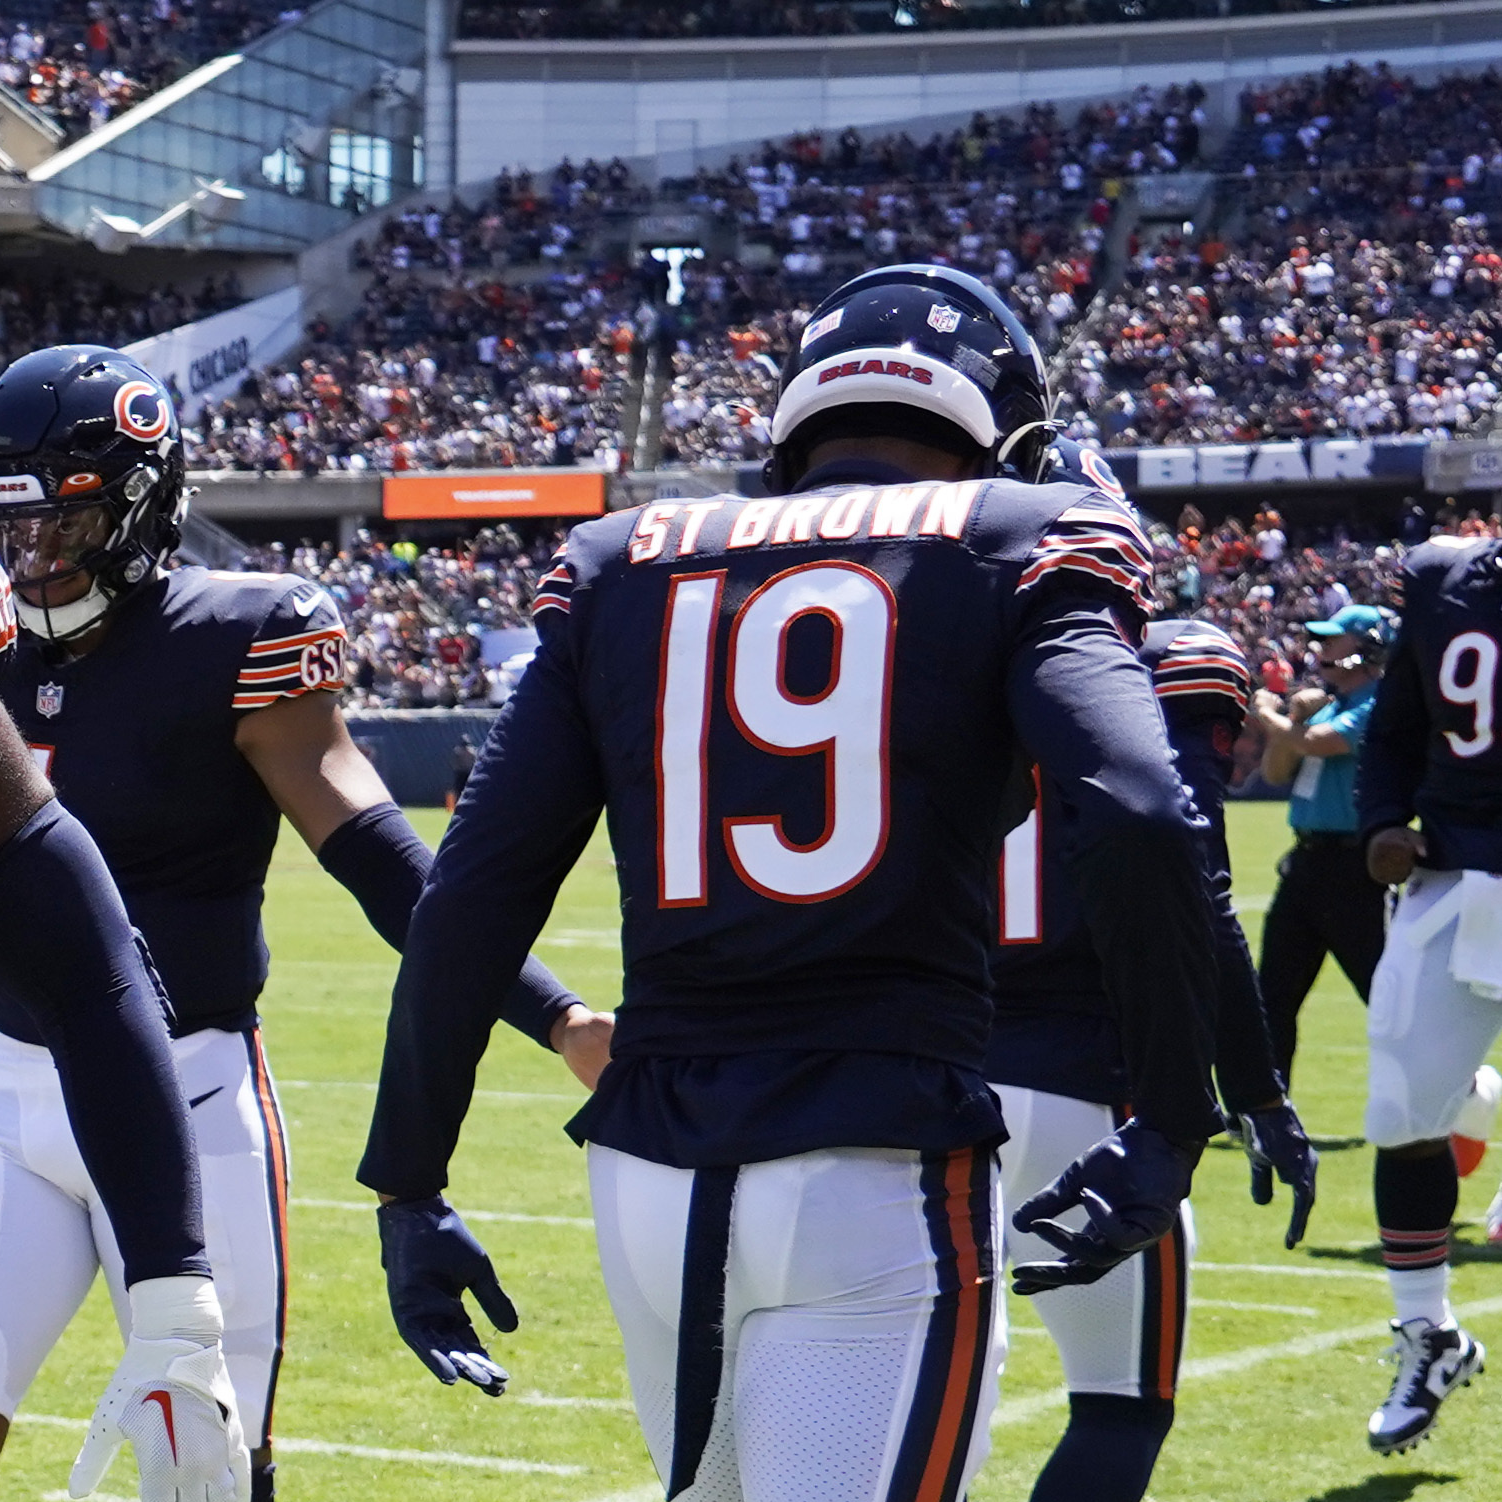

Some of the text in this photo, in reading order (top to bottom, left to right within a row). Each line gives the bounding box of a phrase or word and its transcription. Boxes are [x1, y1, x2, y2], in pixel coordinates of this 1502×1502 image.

[817, 360, 933, 385] BEARS
[1137, 440, 1374, 488] BEAR
[630, 482, 985, 564] ST BROWN
[656, 559, 897, 909] 19
